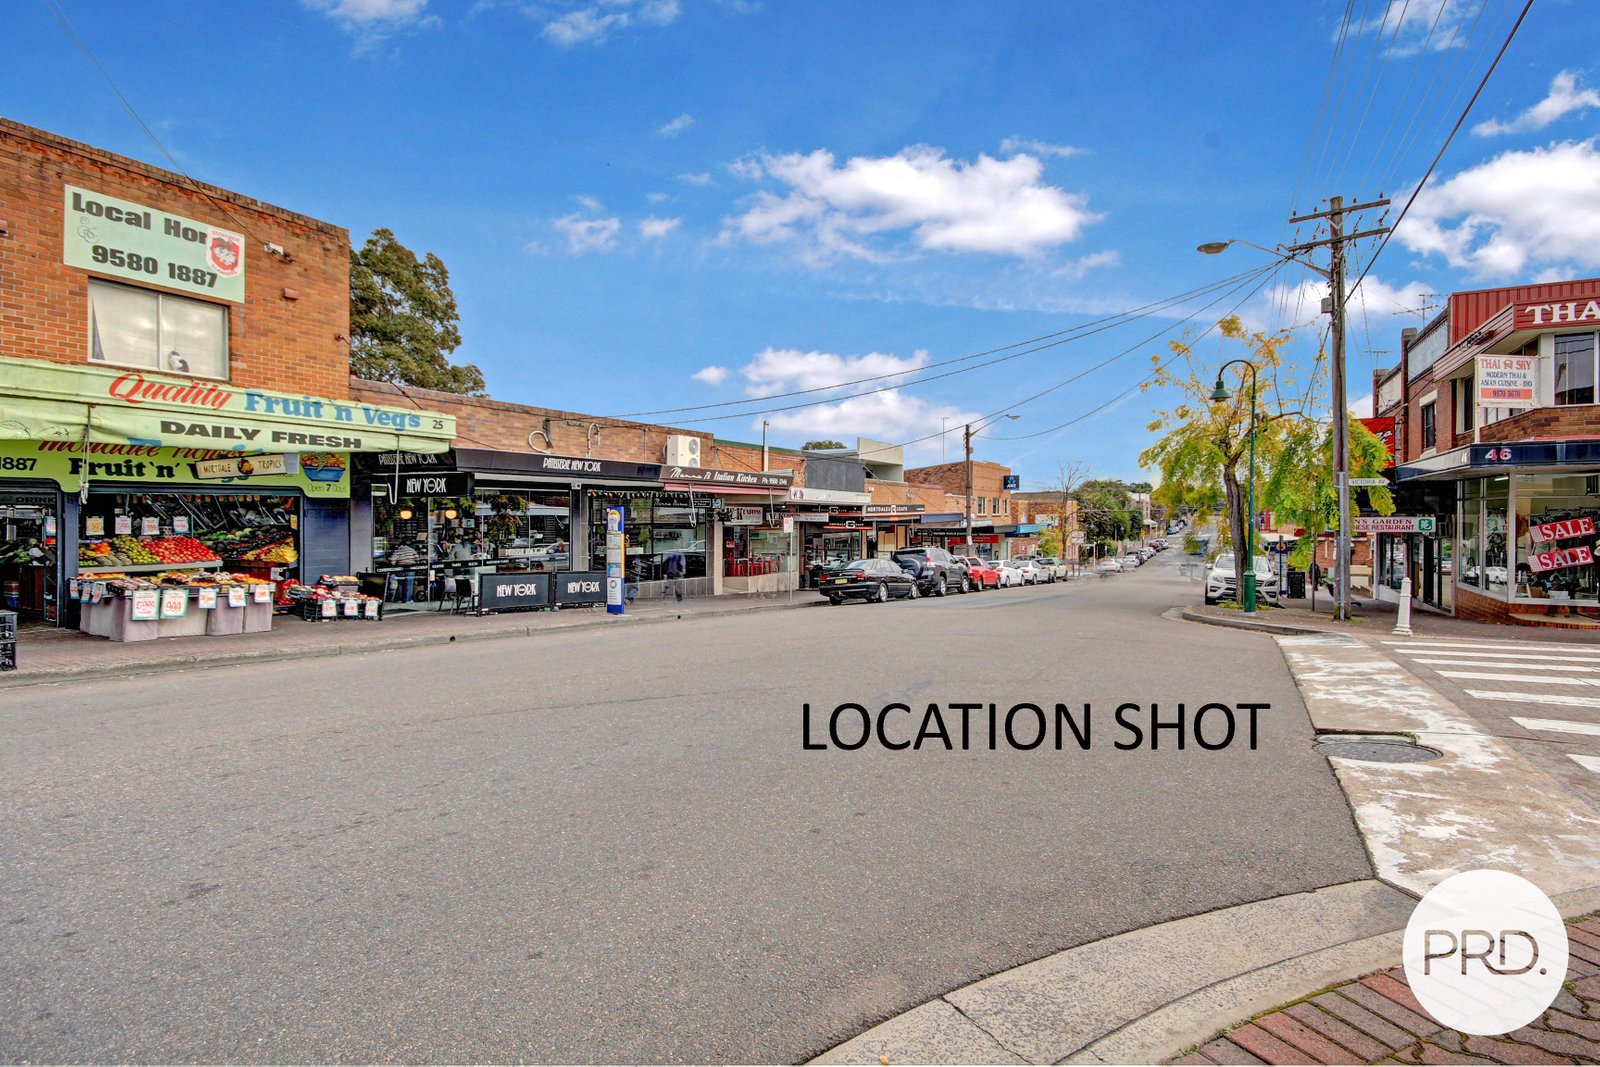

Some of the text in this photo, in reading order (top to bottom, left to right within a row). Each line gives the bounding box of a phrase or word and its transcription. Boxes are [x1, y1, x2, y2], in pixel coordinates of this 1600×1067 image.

[72, 192, 151, 230] Local
[92, 245, 218, 288] 9580 1887
[1480, 359, 1532, 370] THAI SKY
[109, 373, 232, 410] Quality
[245, 391, 324, 419] Fruit
[363, 407, 421, 432] Veg's
[432, 420, 444, 430] 25
[160, 420, 361, 449] DAILY FRESH
[417, 454, 438, 465] YORK
[1485, 449, 1512, 461] 46
[69, 458, 146, 476] Fruit
[203, 463, 231, 473] MORTDALE
[258, 460, 282, 469] TROPICS
[543, 458, 601, 472] PATISSERIE NEW YORK
[713, 471, 735, 482] Italian
[736, 473, 758, 484] Kitchen
[306, 483, 348, 494] Open 7 Days
[406, 478, 447, 494] NEW YORK
[1542, 518, 1594, 540] SALE
[1539, 547, 1590, 569] SALE
[496, 583, 537, 598] NEW YORK
[567, 581, 600, 594] NEW YORK
